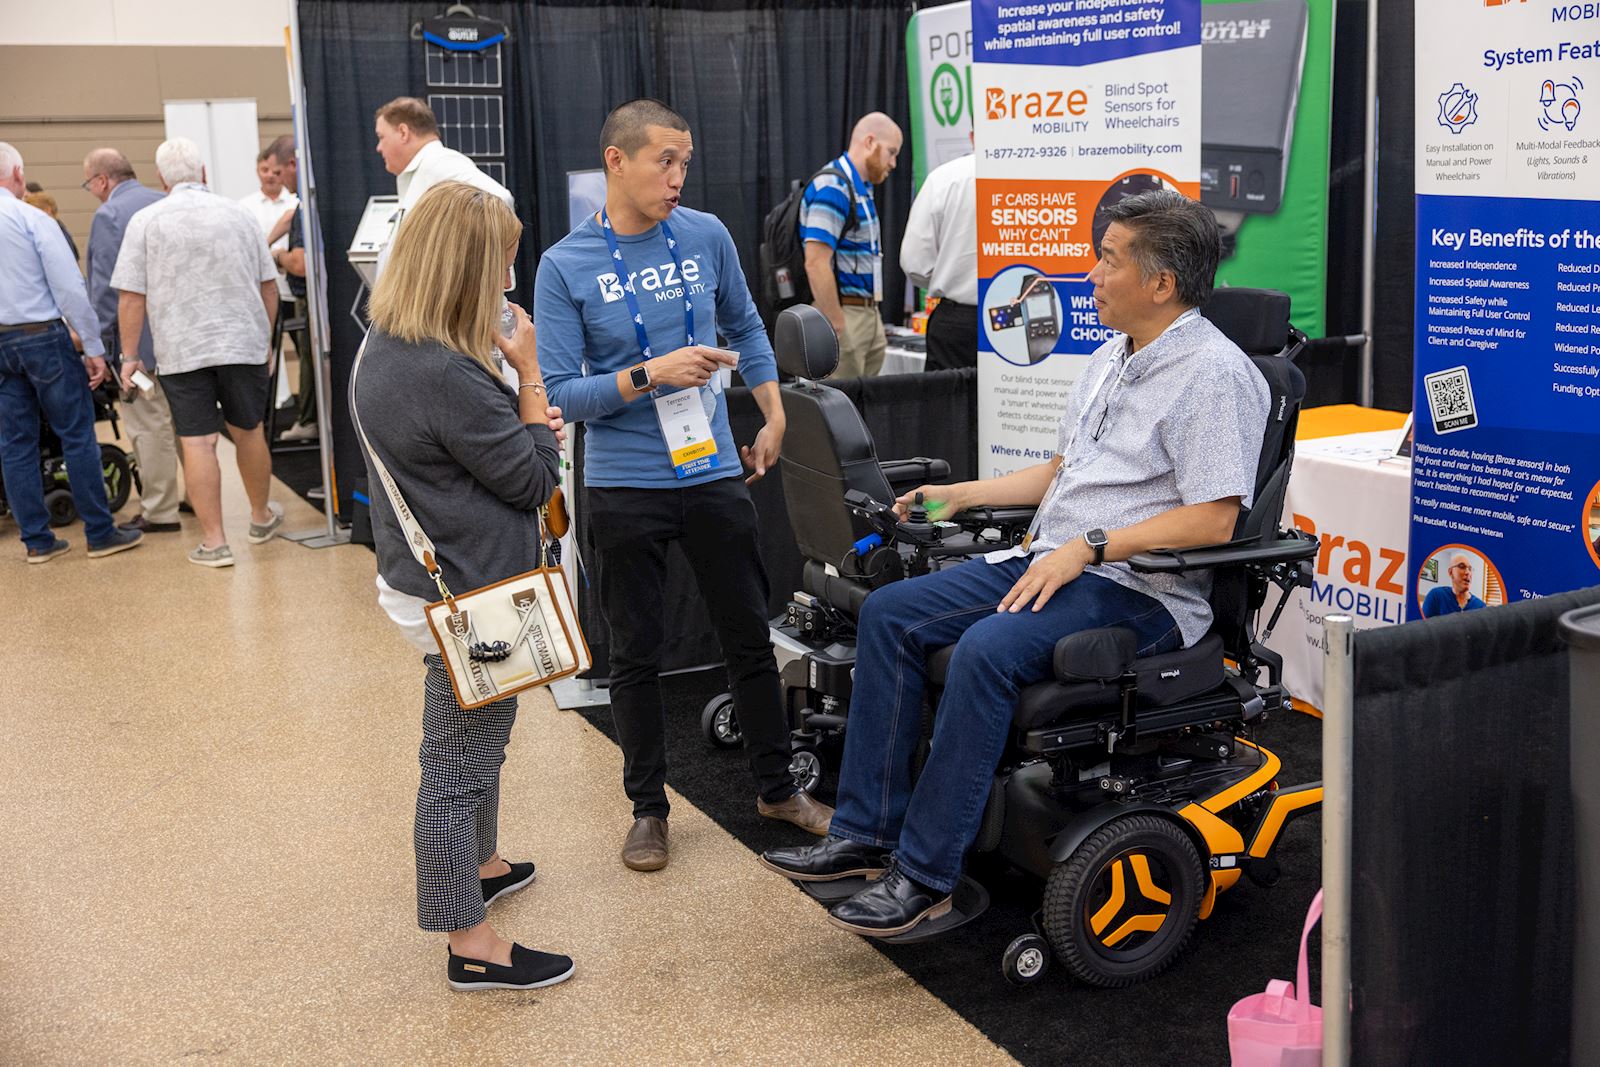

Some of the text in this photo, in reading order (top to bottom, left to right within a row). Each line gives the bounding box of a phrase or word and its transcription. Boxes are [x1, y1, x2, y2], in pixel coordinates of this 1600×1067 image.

[998, 4, 1045, 19] Increase
[1047, 1, 1074, 16] your
[998, 7, 1165, 36] spatial awareness and safety
[984, 21, 1181, 51] while maintaining full user control!
[1483, 47, 1553, 71] System
[1105, 81, 1169, 98] Blind Spot
[985, 87, 1089, 120] Braze
[1105, 97, 1176, 113] Sensors for
[1033, 121, 1089, 134] MOBILITY
[1105, 115, 1180, 130] Wheelchairs
[985, 143, 1182, 160] 1-877-272-9326 brazemobility.com
[1425, 142, 1494, 154] Easy Installation on
[1516, 140, 1561, 151] Multi-Modal
[1426, 157, 1493, 167] Manual and Power
[1553, 155, 1580, 165] Sounds
[1581, 155, 1588, 164] &
[1435, 172, 1481, 181] Wheelchairs
[1537, 171, 1576, 181] Vibrations)
[992, 192, 1076, 206] IF CARS HAVE
[991, 208, 1078, 226] SENSORS
[999, 228, 1070, 241] WHY CAN'T
[1431, 229, 1465, 250] Key
[1469, 228, 1545, 248] Benefits
[1549, 229, 1570, 249] of
[982, 242, 1091, 257] WHEELCHAIRS?
[1429, 260, 1517, 271] Increased Independence
[1558, 263, 1592, 273] Reduced
[596, 259, 700, 303] Braze
[1429, 277, 1530, 289] Increased Spatial Awareness
[1557, 282, 1591, 293] Reduced
[1428, 294, 1508, 307] Increased Safety while
[1556, 302, 1590, 313] Reduced
[1070, 311, 1098, 325] THE
[1428, 306, 1531, 321] Maintaining Full User Control
[1428, 324, 1526, 339] Increased Peace of Mind for
[1555, 322, 1589, 334] Reduced
[1428, 336, 1498, 351] Client and Caregiver
[1554, 343, 1589, 355] Widened
[1553, 362, 1599, 378] Successfully
[1015, 376, 1033, 384] blind
[993, 387, 1019, 395] manual
[1035, 390, 1057, 398] power
[1552, 382, 1584, 397] Funding
[666, 394, 691, 406] Terrence
[997, 411, 1021, 419] detects
[1001, 423, 1028, 433] through
[1444, 419, 1459, 428] SCAN
[991, 444, 1021, 456] Where
[1024, 448, 1041, 458] Are
[1449, 448, 1470, 459] doubt,
[1471, 451, 1494, 464] having
[1545, 462, 1553, 471] in
[1554, 463, 1571, 474] both
[1414, 455, 1424, 463] the
[1423, 456, 1441, 466] front
[1442, 459, 1456, 468] and
[1456, 462, 1470, 471] rear
[1471, 463, 1484, 473] has
[1485, 465, 1501, 475] been
[1502, 468, 1514, 477] the
[1530, 474, 1553, 484] meow
[1553, 476, 1565, 487] for
[1414, 467, 1573, 500] me. is everything had hoped for and expected.
[1435, 482, 1460, 493] hesitate
[1461, 486, 1468, 495] to
[1469, 488, 1509, 501] recommend
[1421, 498, 1439, 509] really
[1439, 501, 1461, 512] makes
[1461, 506, 1473, 514] me
[1473, 508, 1492, 517] more
[1492, 510, 1515, 523] mobile,
[1516, 515, 1531, 526] safe
[1532, 519, 1548, 528] and
[1413, 514, 1423, 523] Phil
[1449, 521, 1458, 529] US
[1458, 523, 1480, 534] Marine
[1480, 527, 1504, 539] Veteran
[1310, 580, 1406, 625] MOBILI
